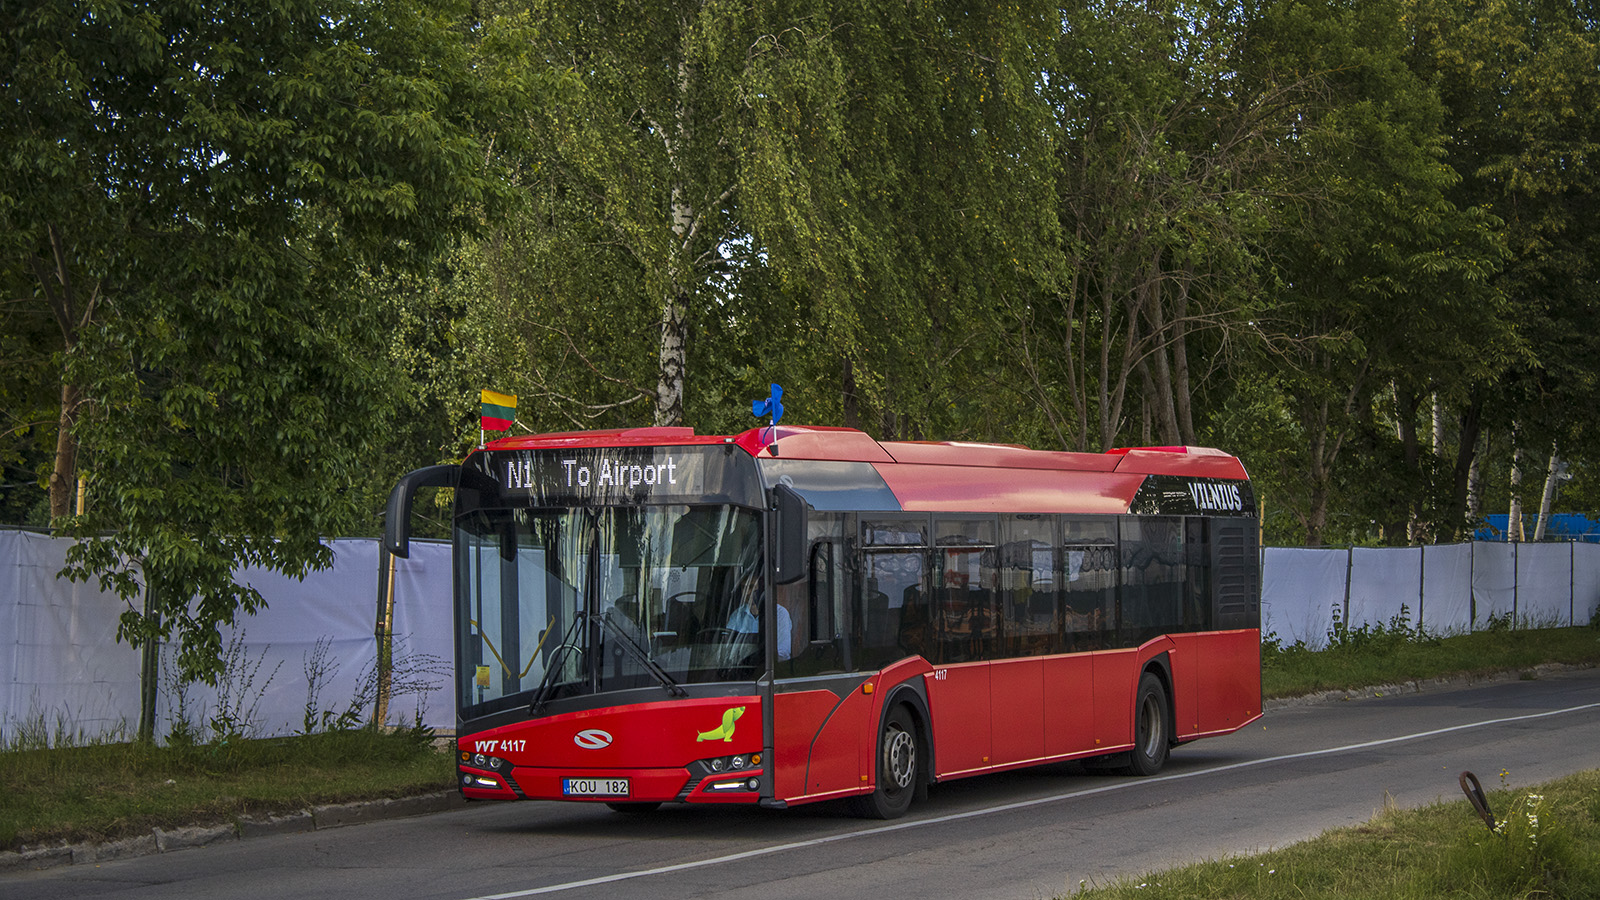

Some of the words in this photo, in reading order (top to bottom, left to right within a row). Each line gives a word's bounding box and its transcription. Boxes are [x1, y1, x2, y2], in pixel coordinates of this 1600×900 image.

[508, 461, 532, 488] N1
[563, 459, 590, 487] To
[599, 456, 677, 489] Airport
[1188, 482, 1242, 511] VILNIUS
[935, 669, 948, 680] 4117
[475, 740, 499, 752] VVT
[500, 739, 526, 752] 4117
[570, 781, 597, 793] KOU
[606, 781, 627, 793] 182
